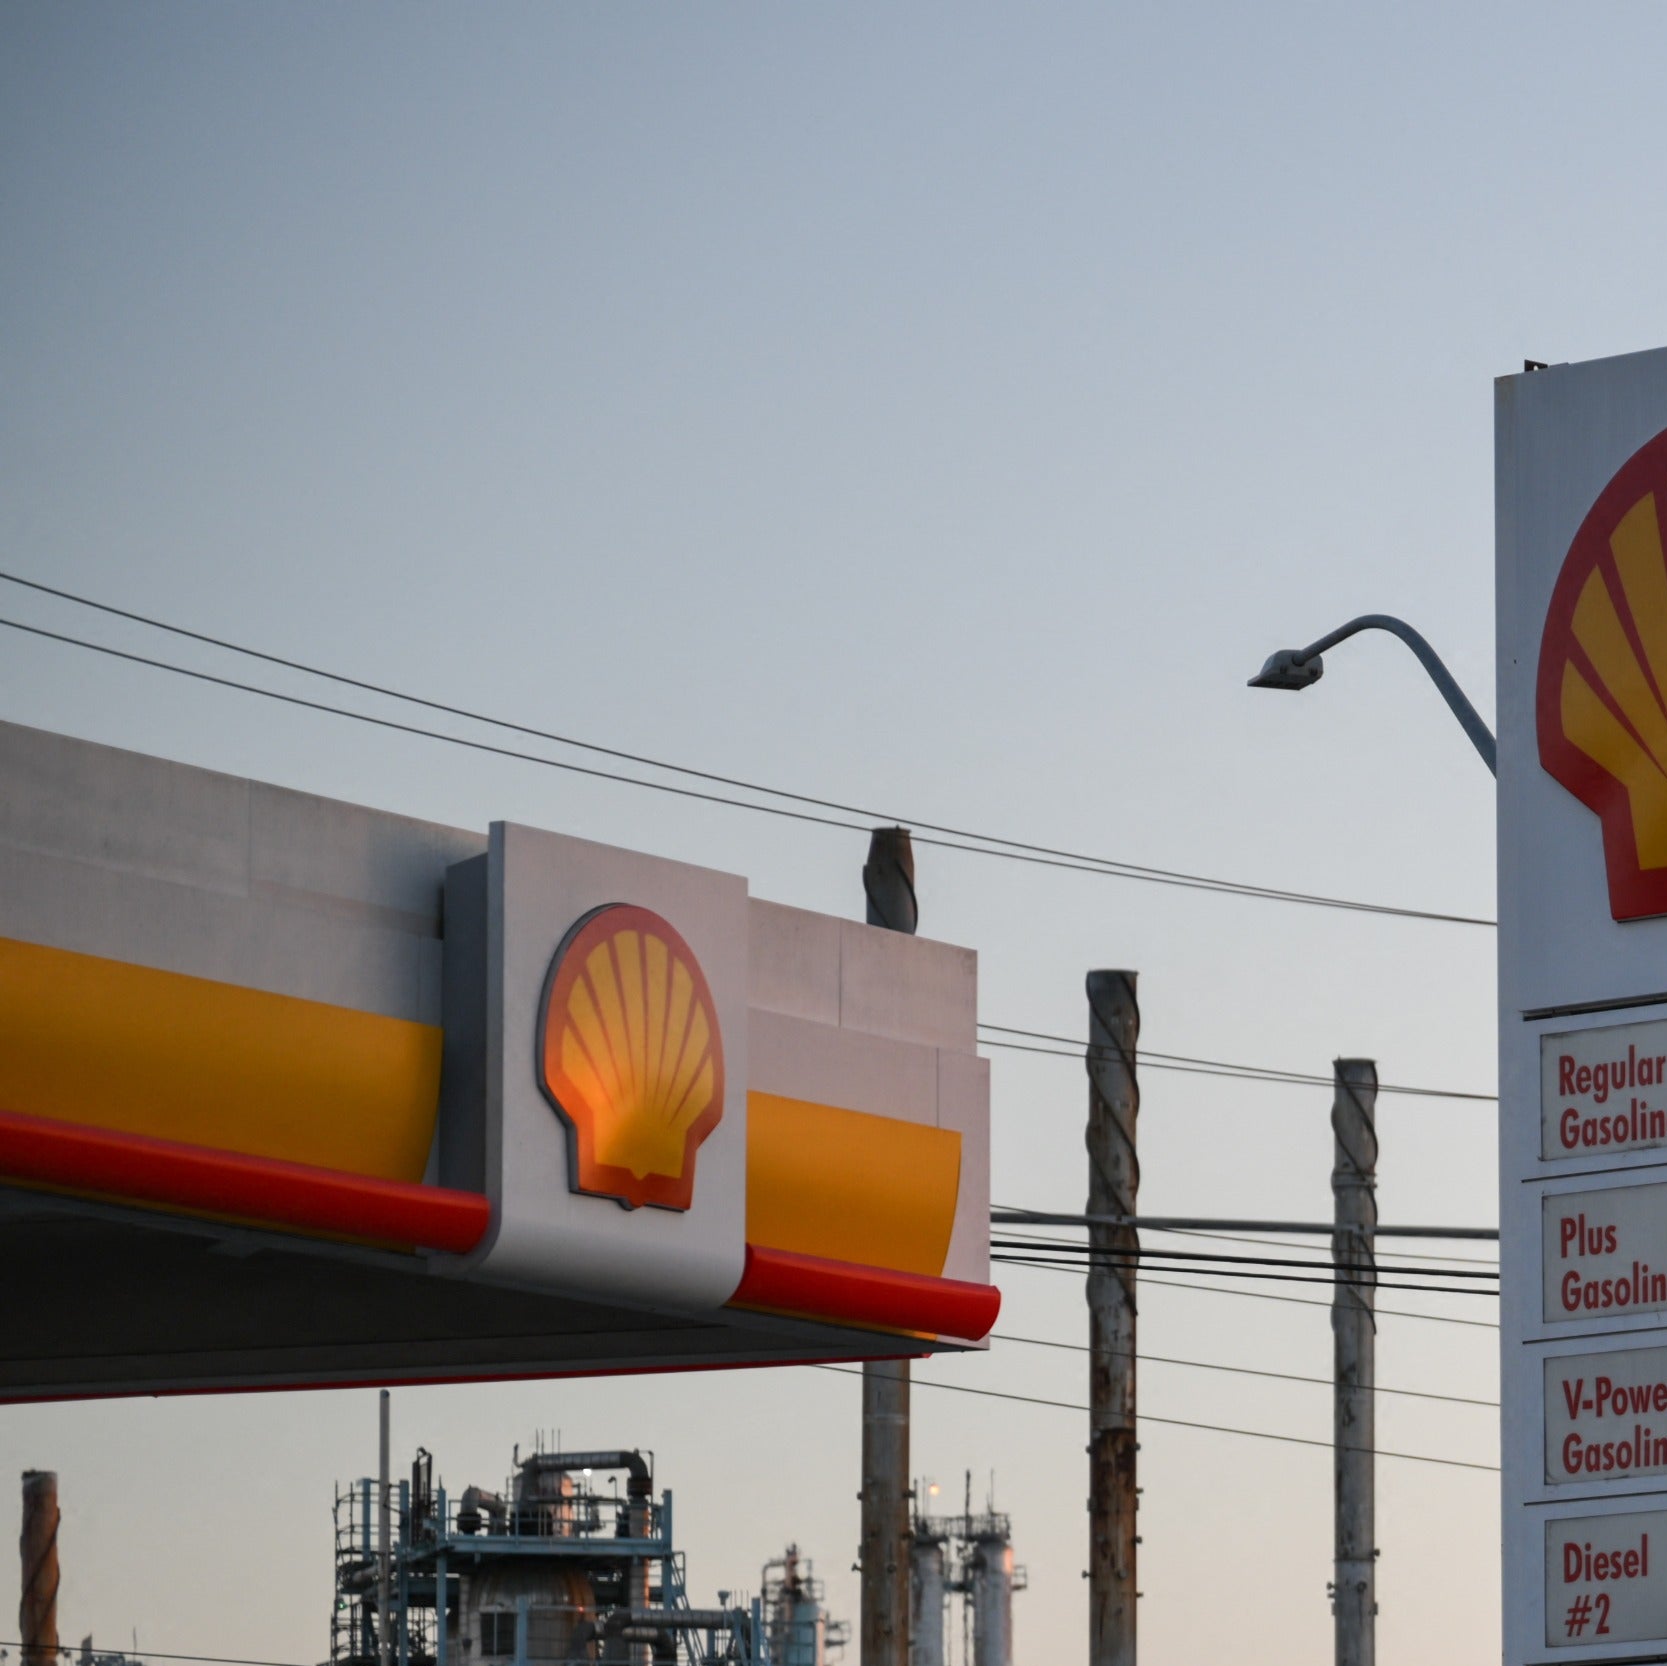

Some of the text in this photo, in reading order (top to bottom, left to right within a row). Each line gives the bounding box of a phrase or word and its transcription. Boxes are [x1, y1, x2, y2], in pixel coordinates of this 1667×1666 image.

[1558, 1044, 1667, 1104] Regular
[1560, 1214, 1617, 1258] Plus
[1562, 1533, 1648, 1584] Diesel
[1565, 1593, 1611, 1637] #2
